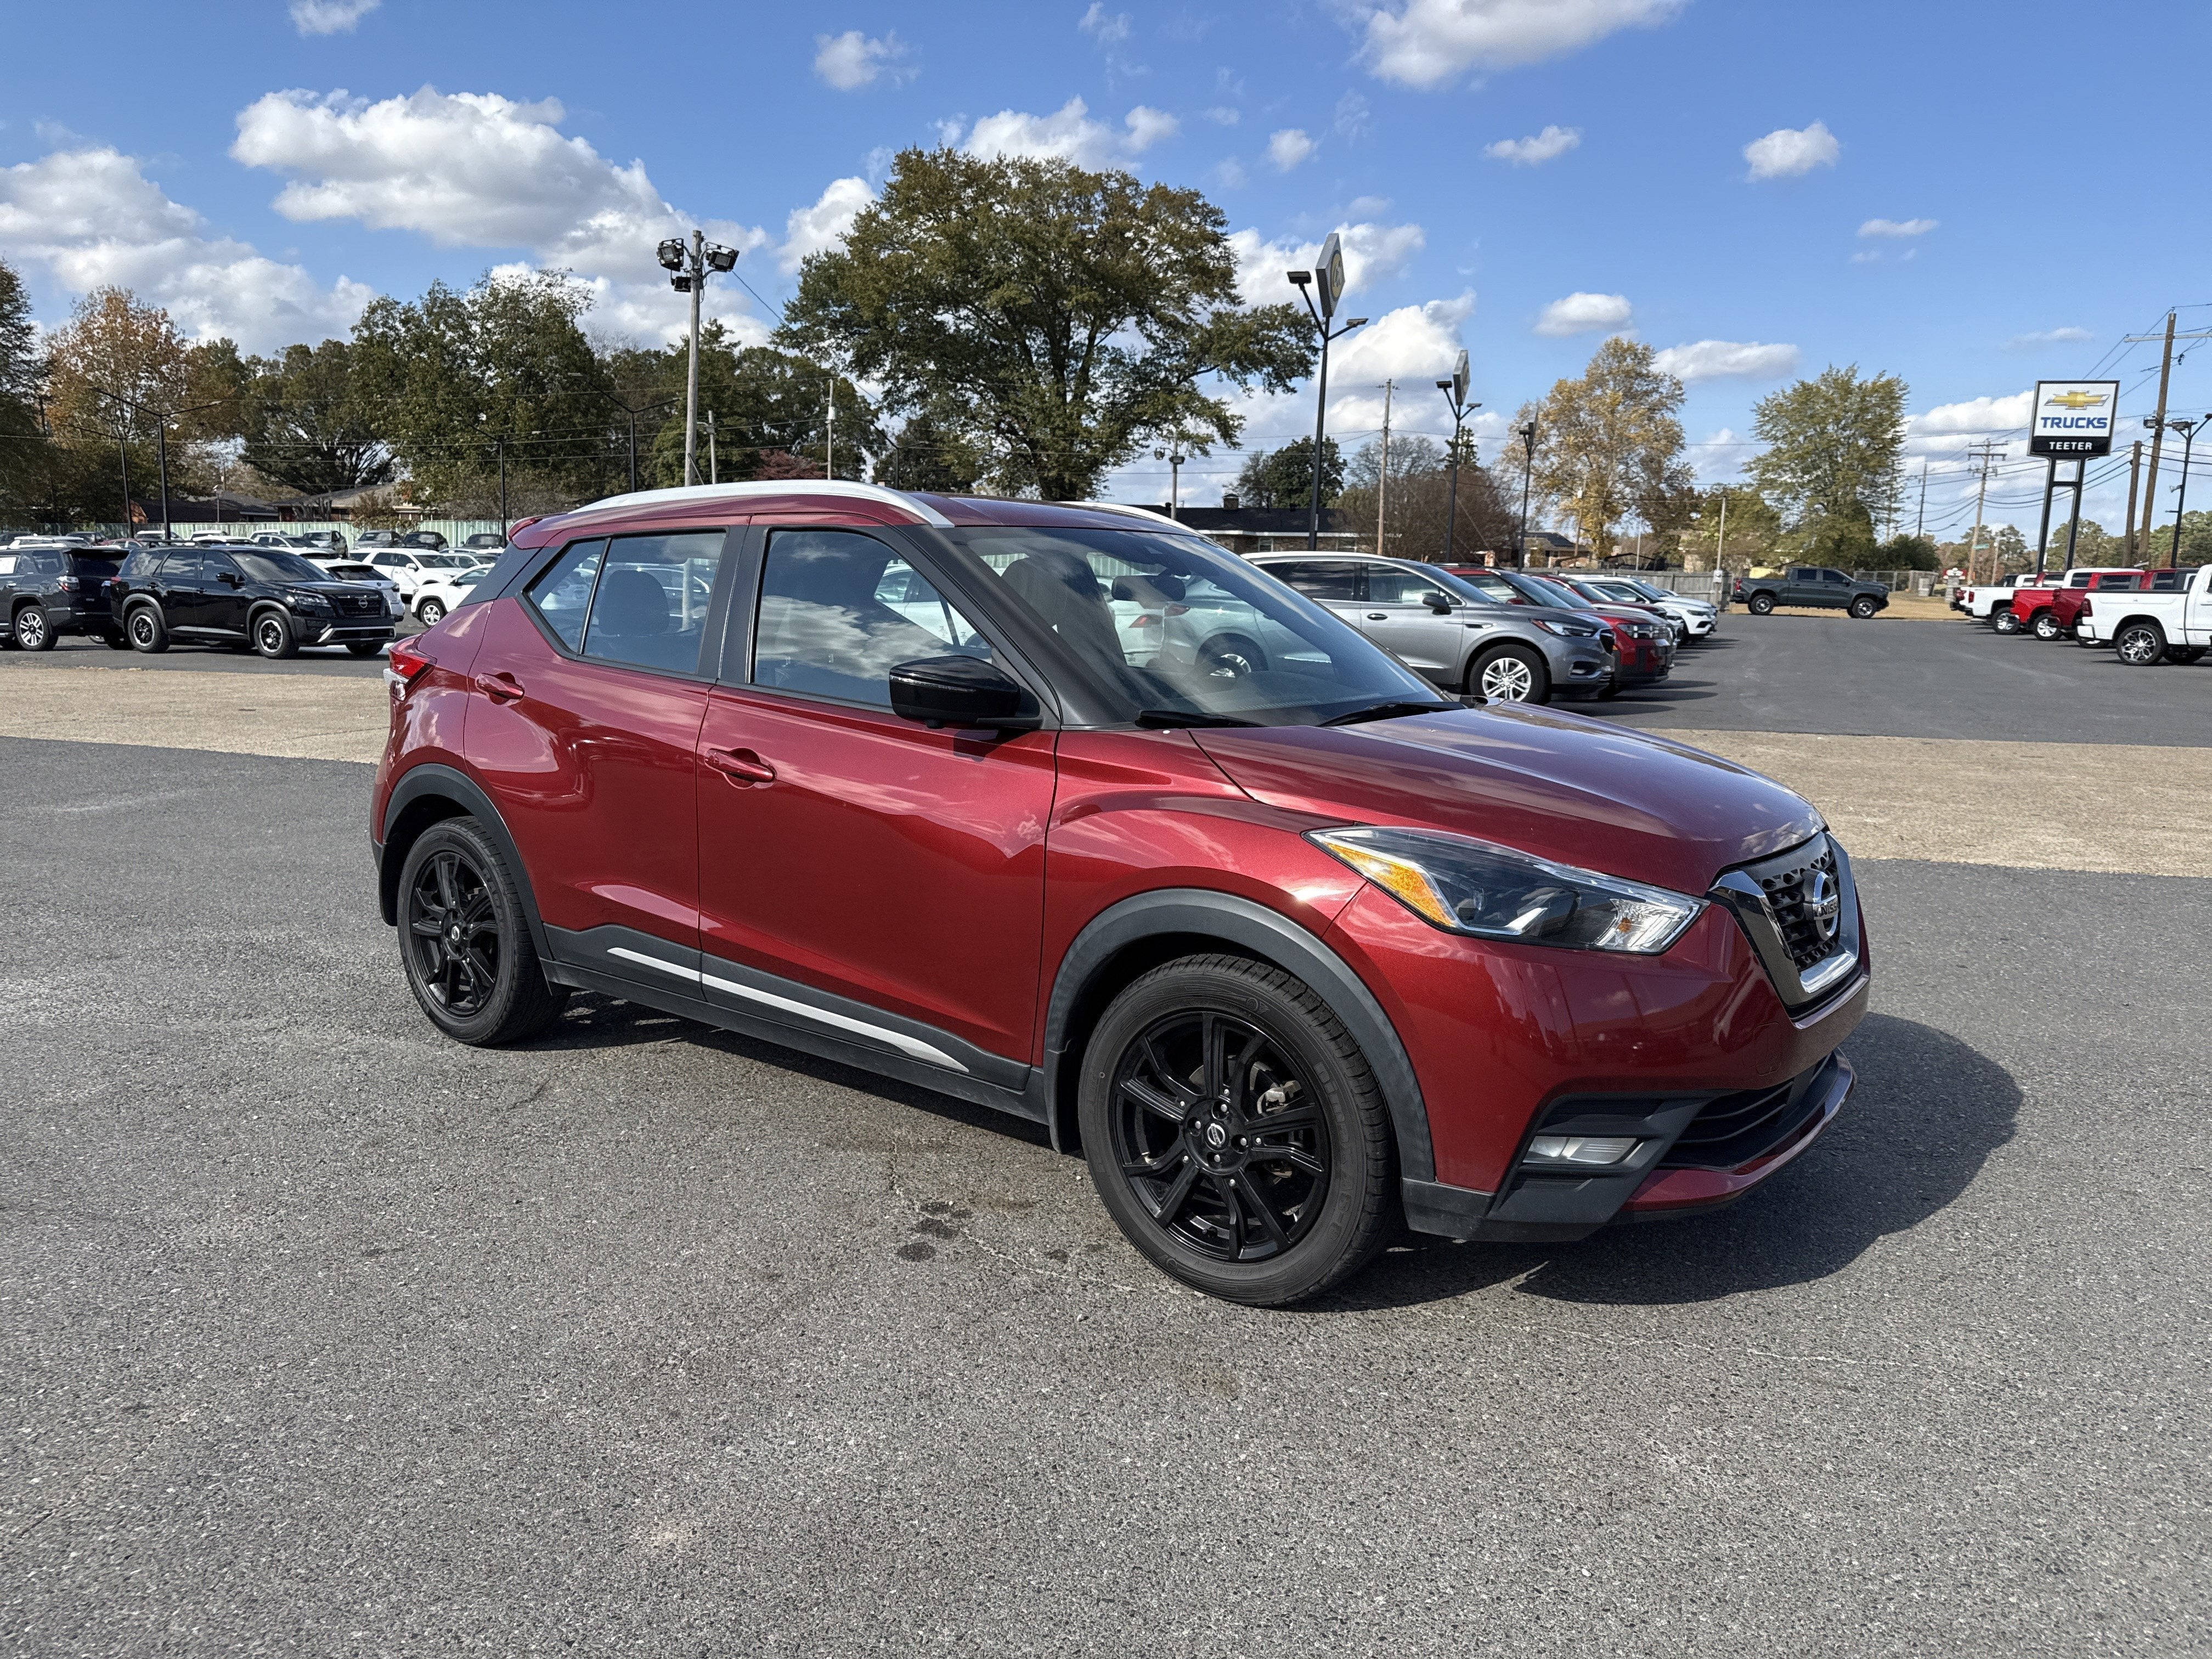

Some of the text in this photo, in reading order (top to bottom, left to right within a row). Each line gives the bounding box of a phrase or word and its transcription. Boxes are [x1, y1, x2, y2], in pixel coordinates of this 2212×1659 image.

[2041, 417, 2108, 428] TRUCKS
[2049, 442, 2092, 450] TEETER
[1821, 901, 1838, 915] NISS
